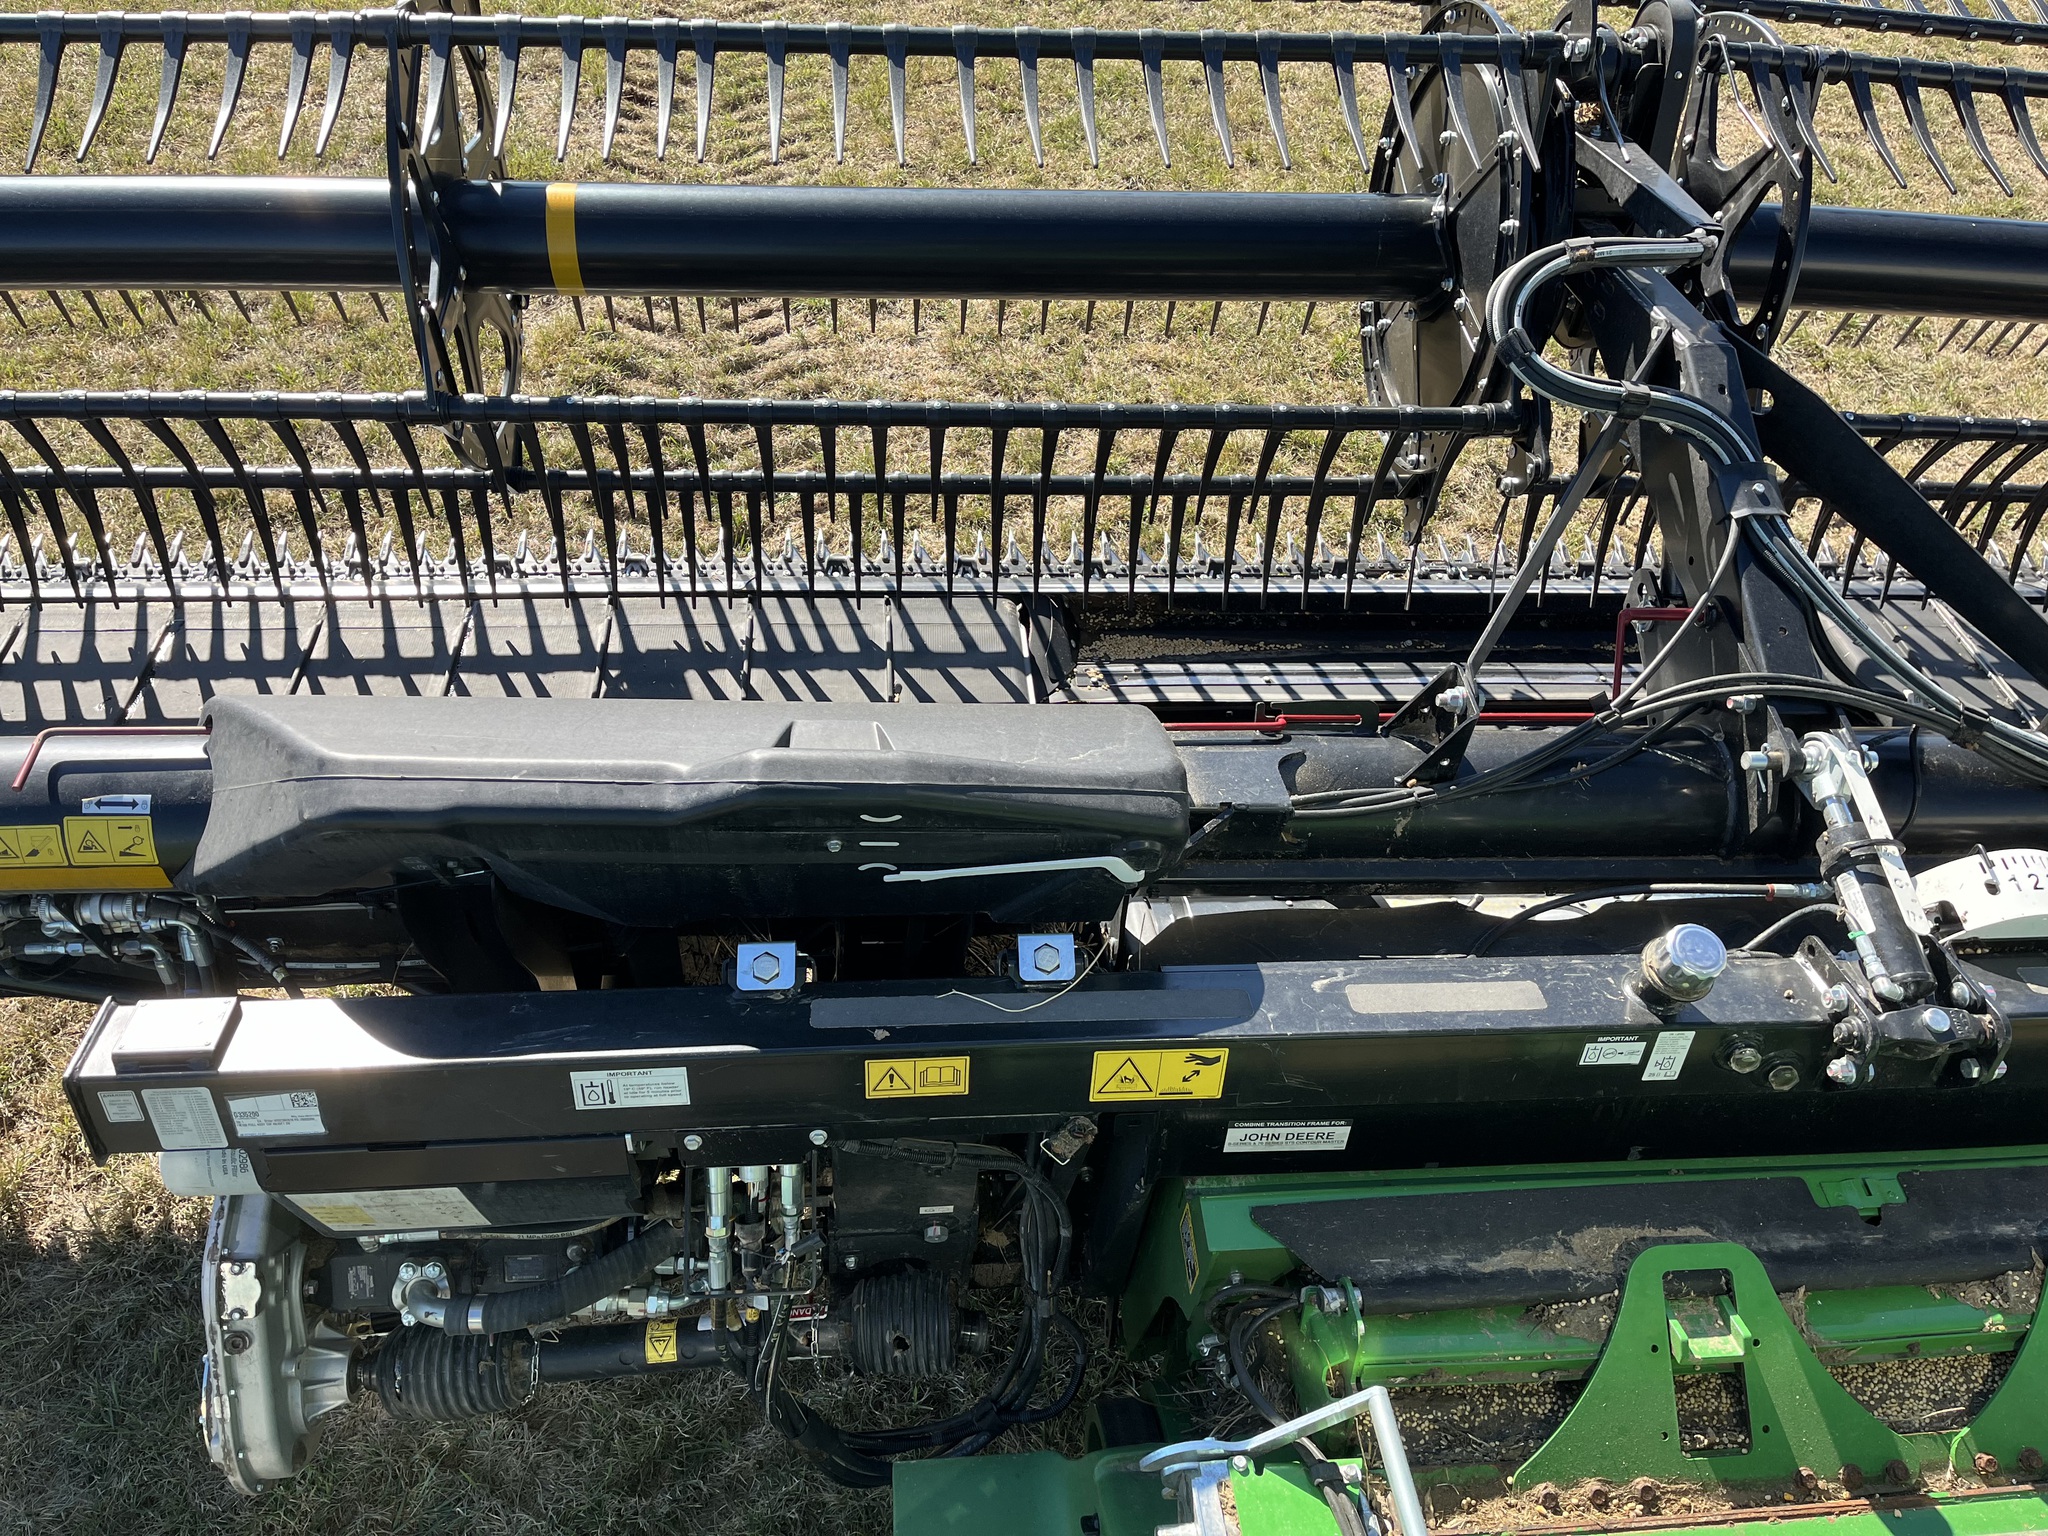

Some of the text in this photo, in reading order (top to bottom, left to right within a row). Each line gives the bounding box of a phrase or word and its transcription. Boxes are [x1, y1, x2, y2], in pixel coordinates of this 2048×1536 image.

[2028, 873, 2044, 890] 2
[1239, 1131, 1336, 1142] JOHN DEERE
[790, 1307, 812, 1316] DAN
